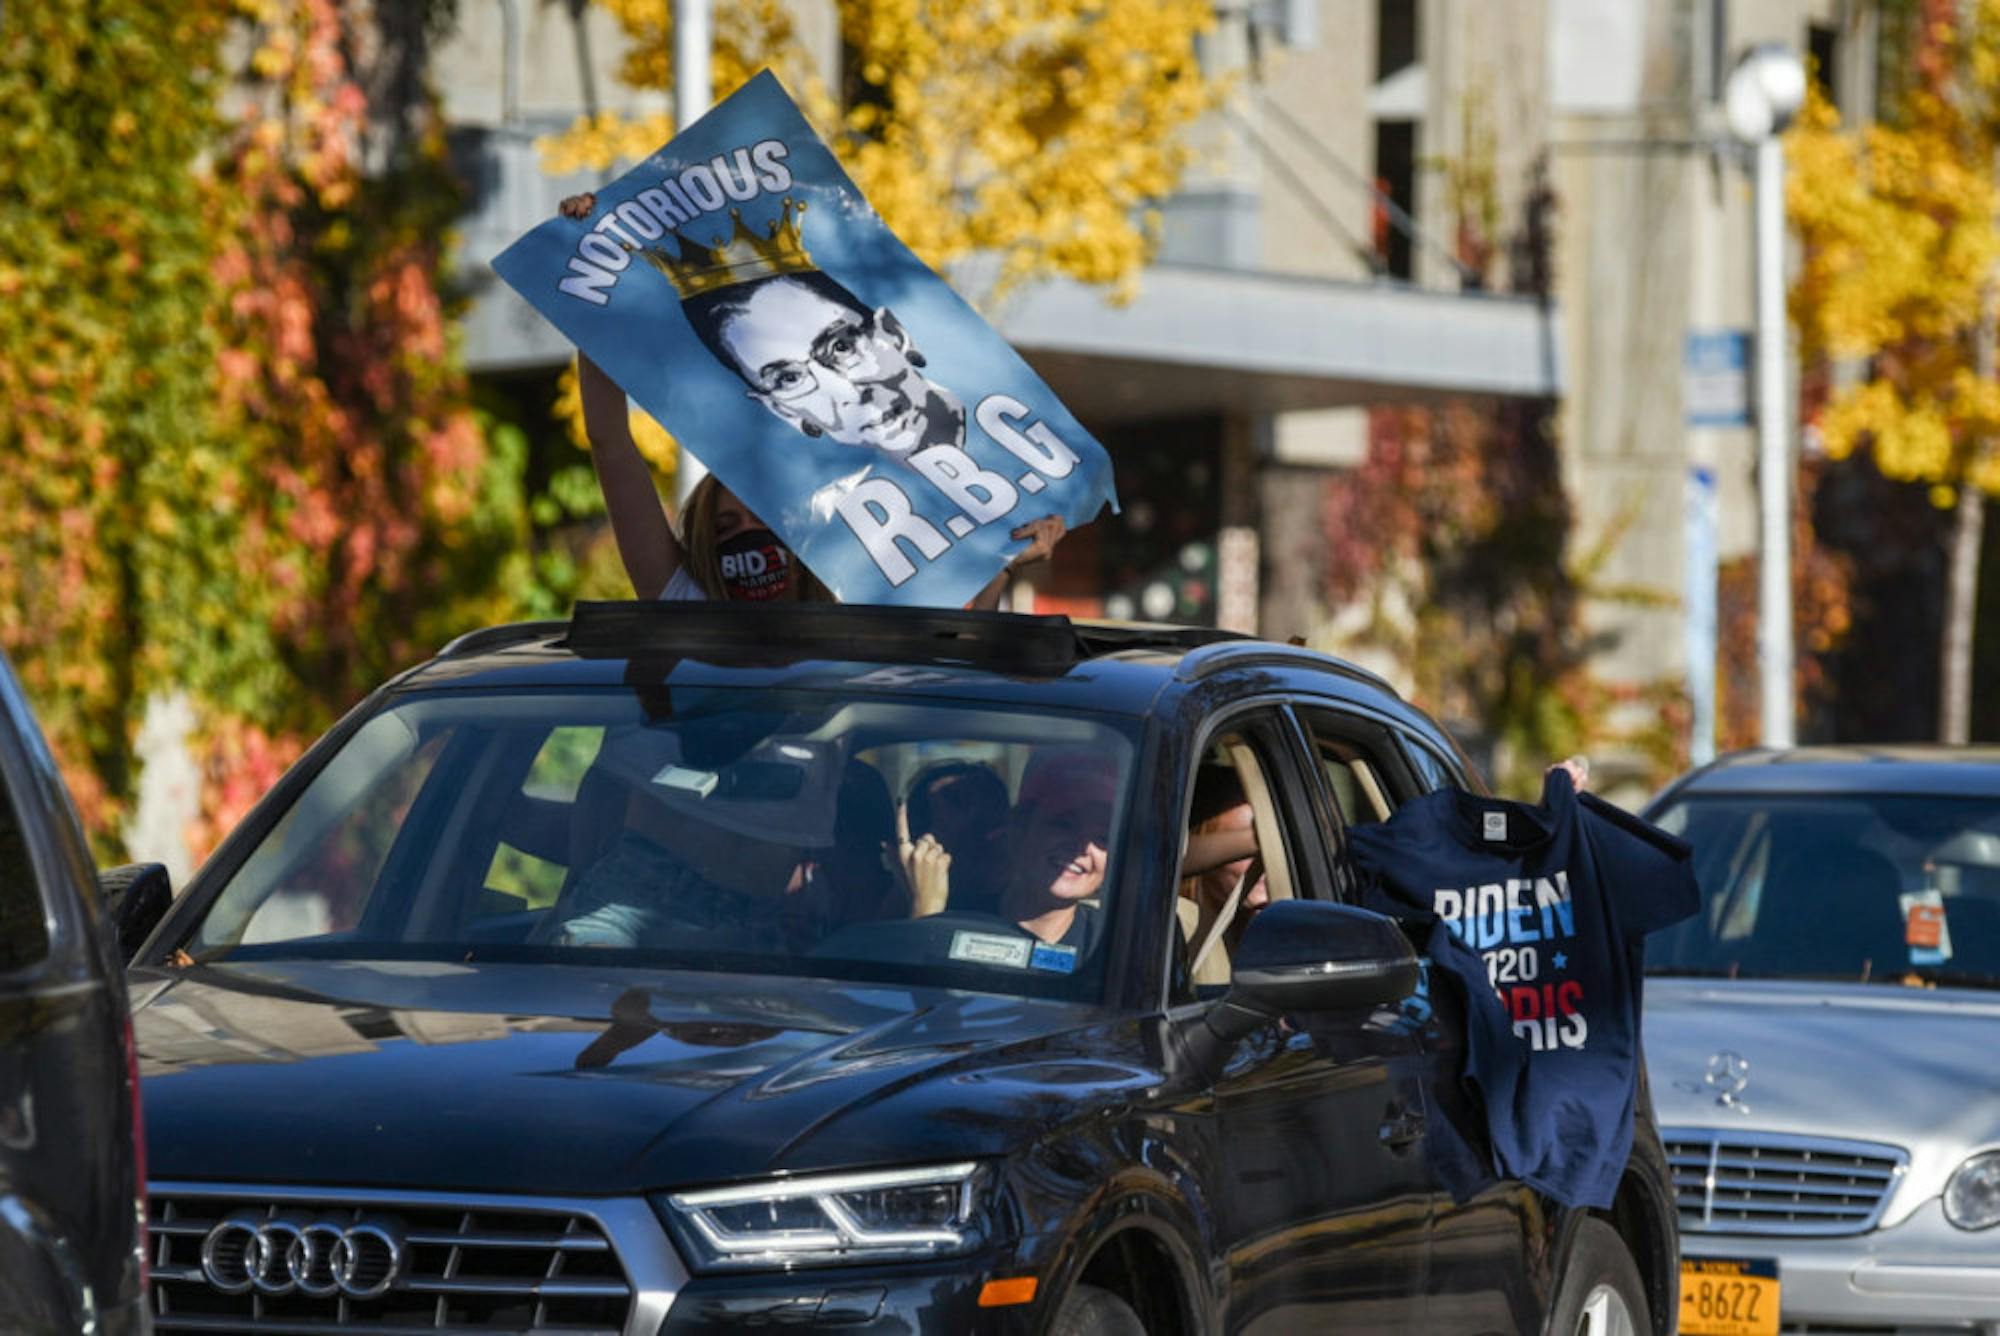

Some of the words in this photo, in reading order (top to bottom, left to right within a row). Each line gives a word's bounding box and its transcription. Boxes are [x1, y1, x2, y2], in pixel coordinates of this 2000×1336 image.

[558, 140, 793, 306] NOTORIOUS
[835, 393, 1082, 589] R.B.G
[1432, 870, 1577, 950] BIDEN
[1698, 1281, 1762, 1323] 8622
